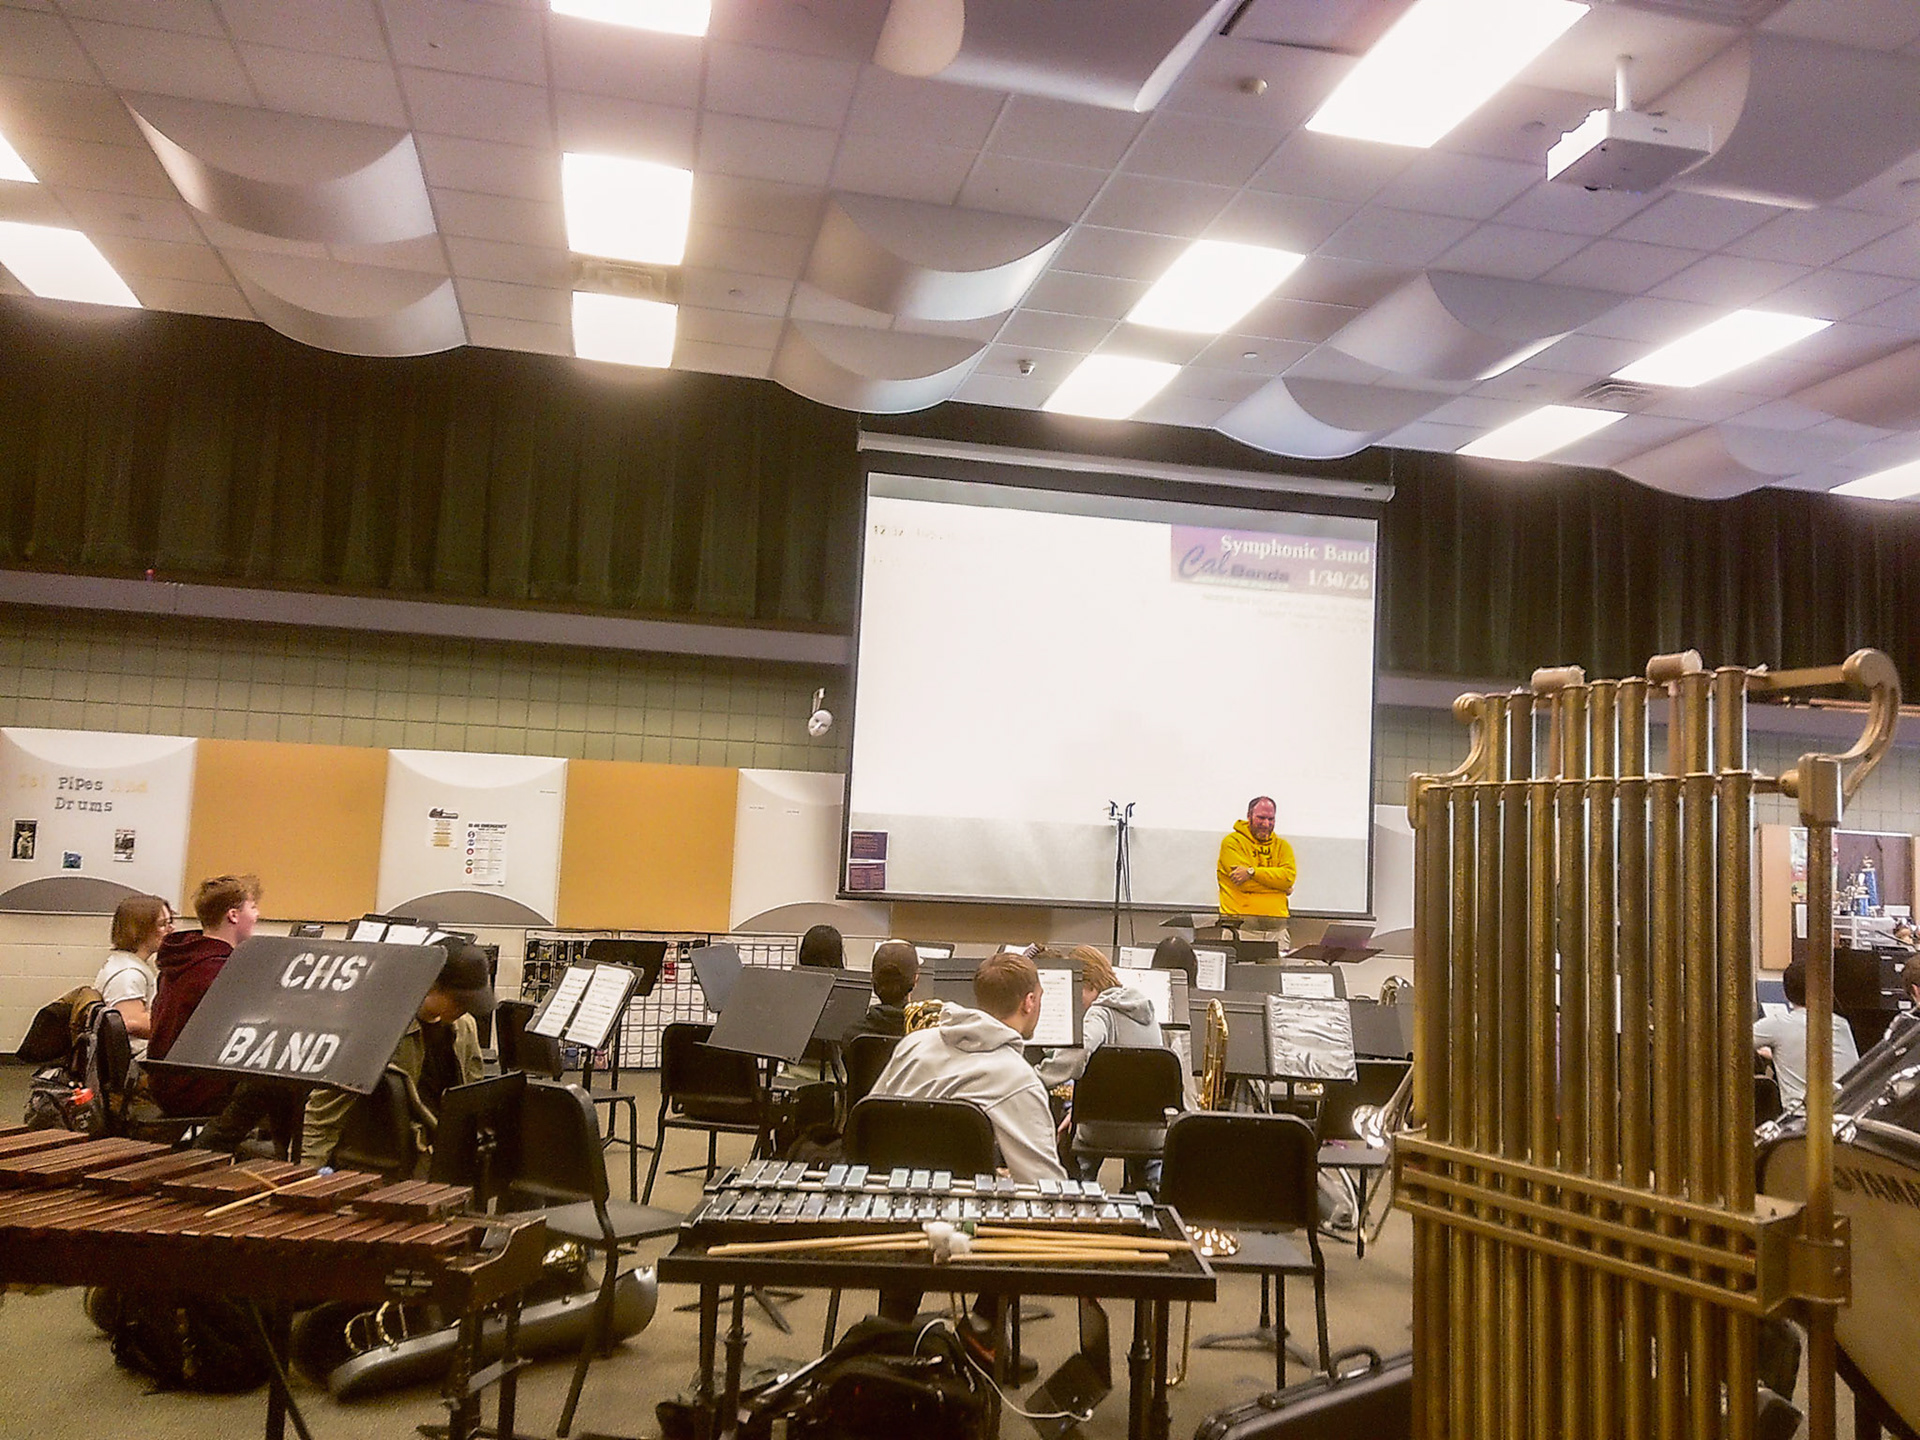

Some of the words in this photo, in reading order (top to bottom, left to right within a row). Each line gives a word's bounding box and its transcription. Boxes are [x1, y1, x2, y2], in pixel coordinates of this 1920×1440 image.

[1179, 545, 1231, 579] Cal
[1220, 535, 1319, 559] Symphonic
[1323, 544, 1370, 564] Band
[1308, 568, 1370, 591] 1/30/26
[54, 796, 113, 812] Drums
[280, 952, 368, 992] CHS
[217, 1026, 340, 1073] BAND
